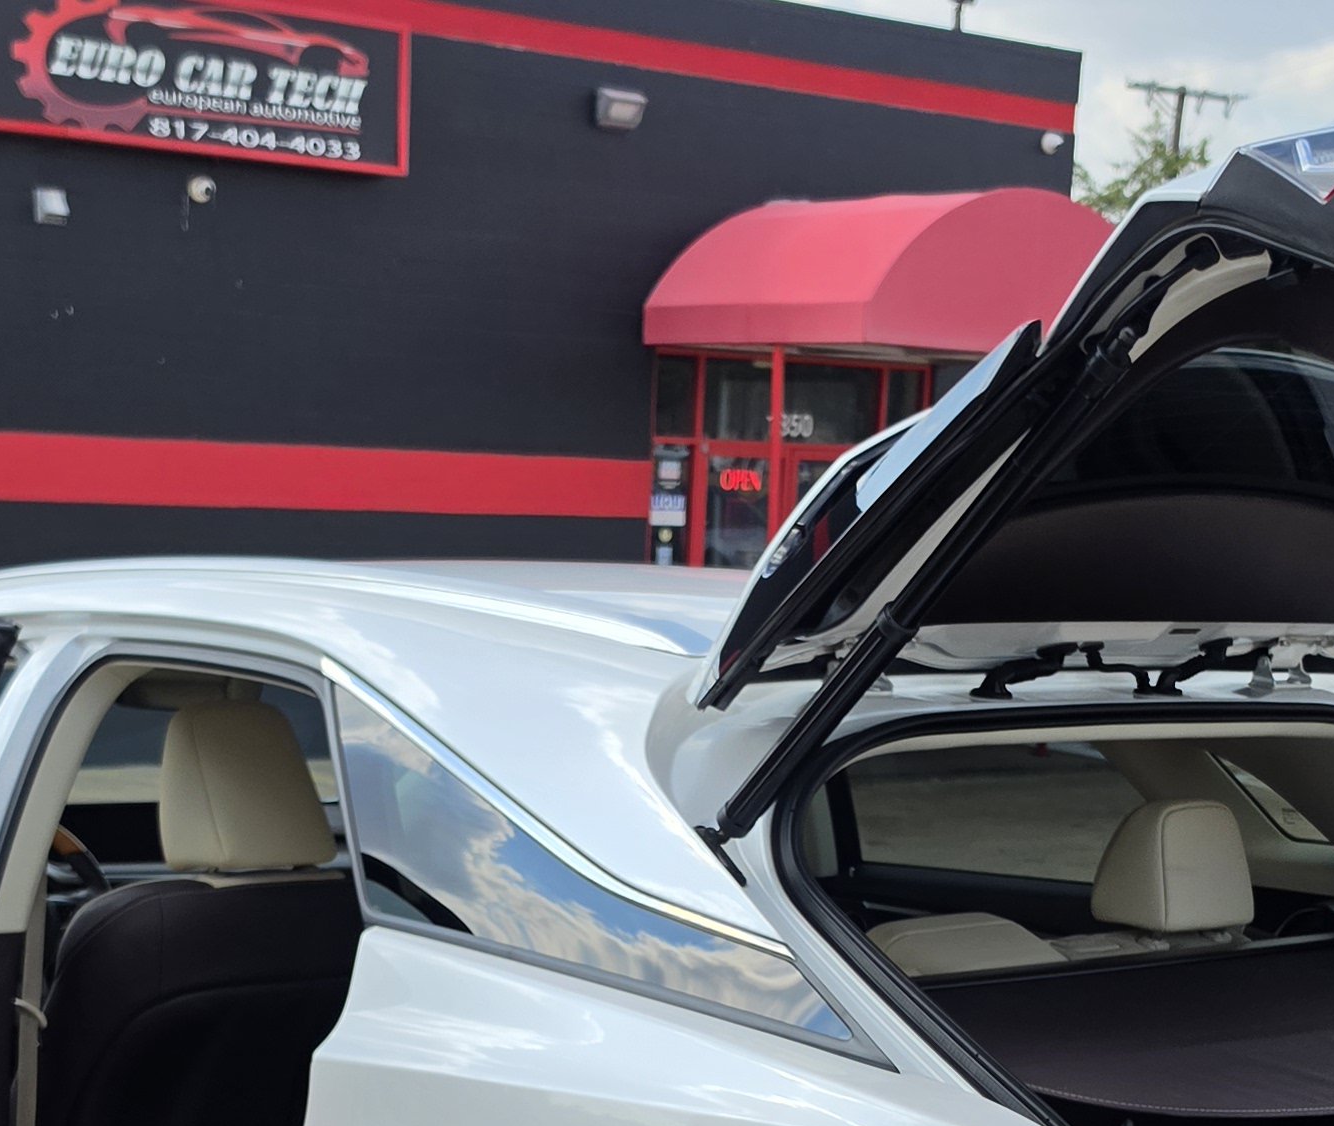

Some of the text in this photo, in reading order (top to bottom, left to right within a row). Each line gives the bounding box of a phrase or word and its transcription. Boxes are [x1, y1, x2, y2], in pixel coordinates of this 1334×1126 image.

[49, 36, 368, 114] EURO CAR TECH
[147, 89, 362, 131] european automotive
[148, 116, 361, 161] 817-404-4033
[720, 468, 763, 491] OPEN
